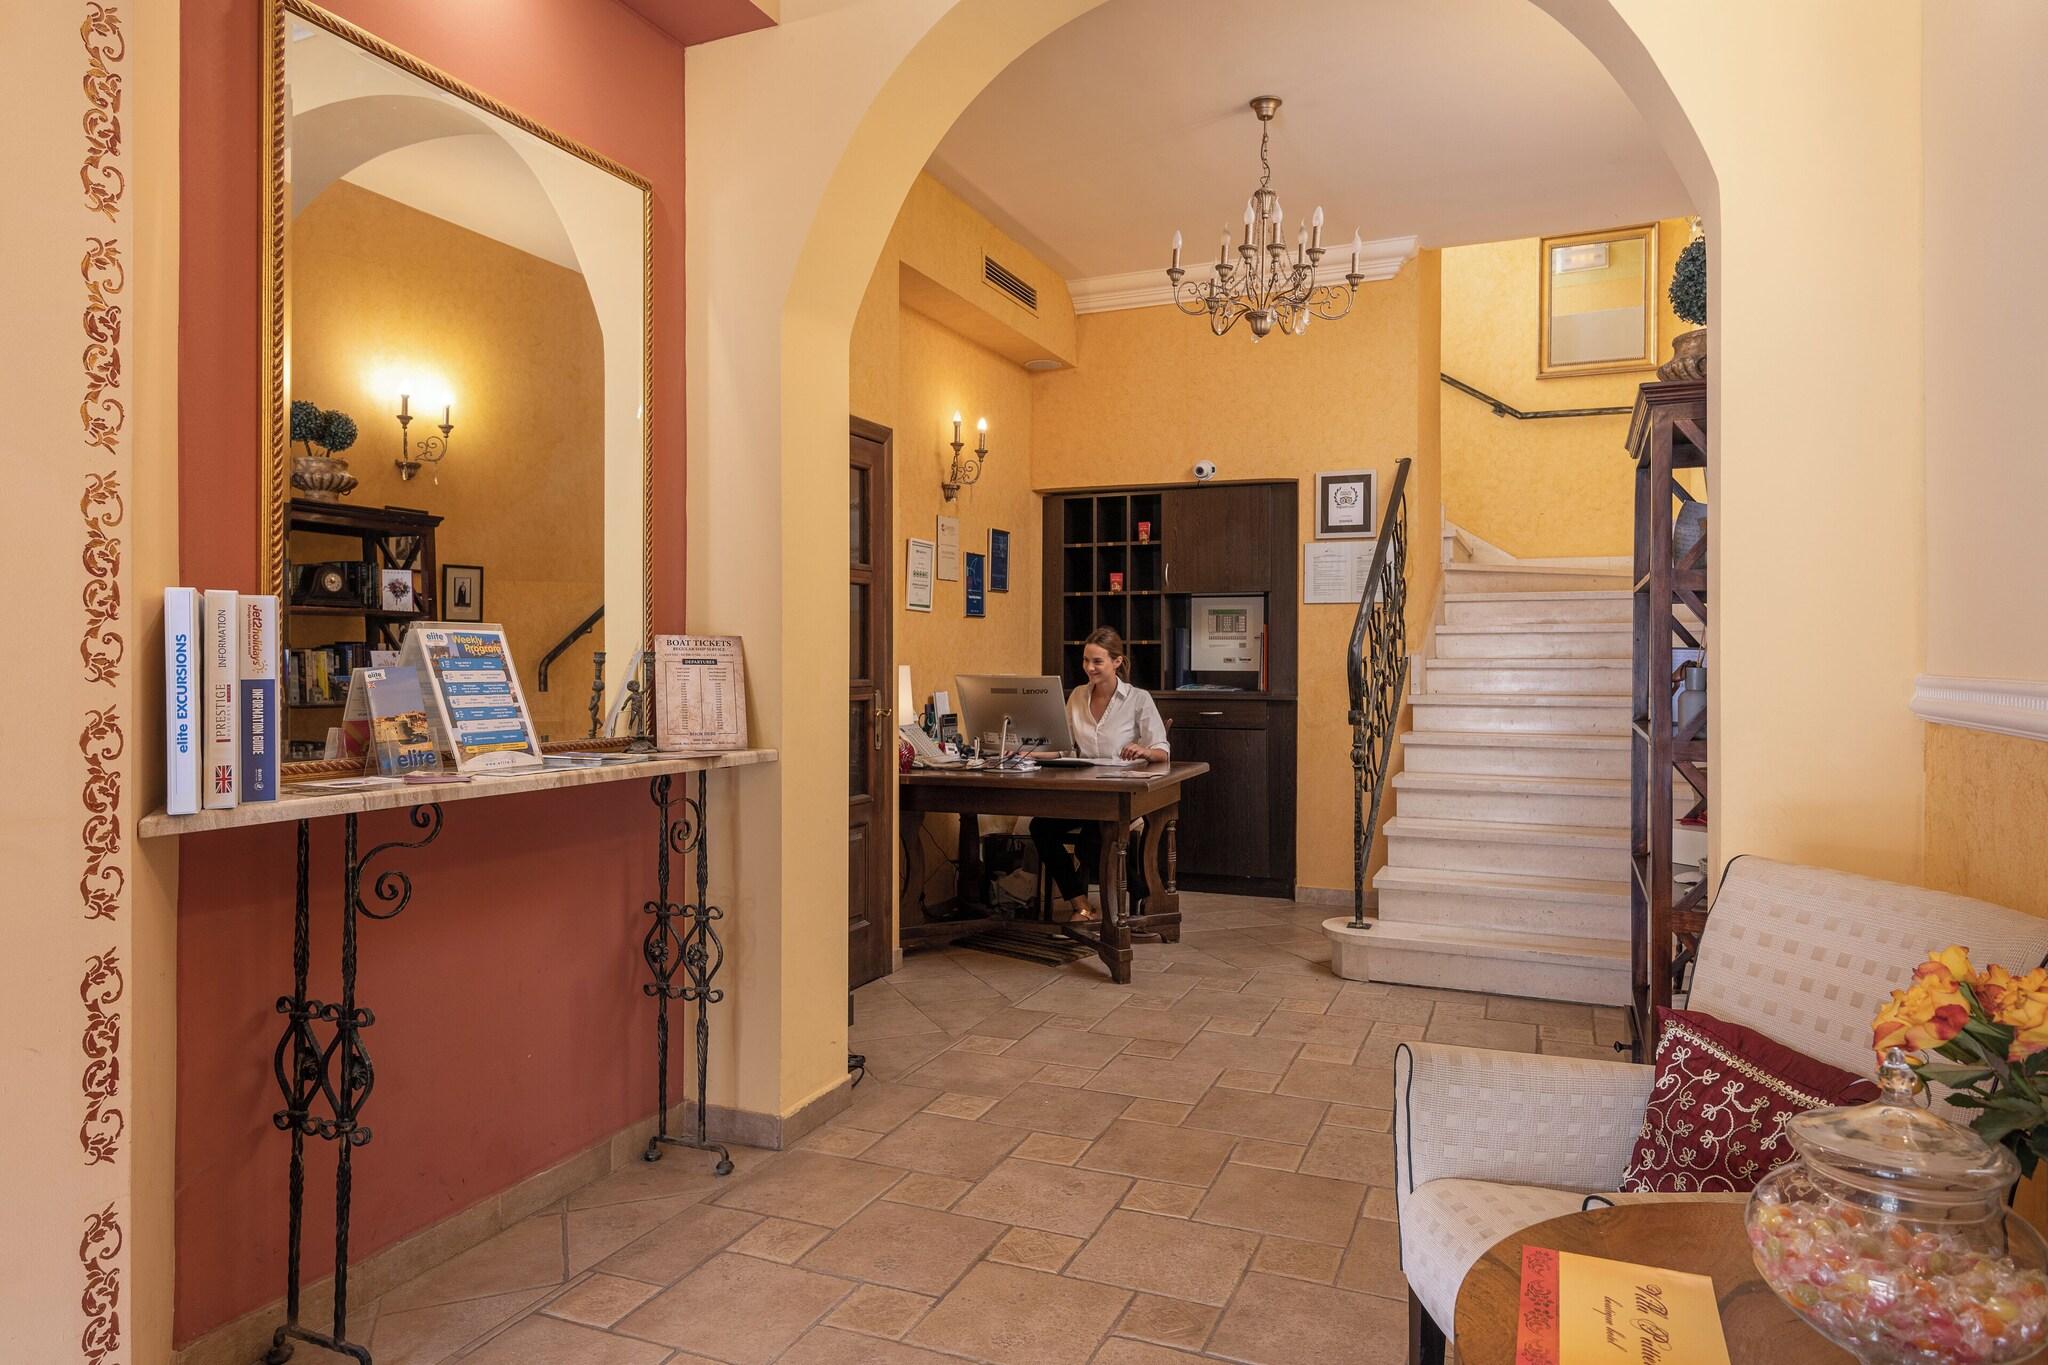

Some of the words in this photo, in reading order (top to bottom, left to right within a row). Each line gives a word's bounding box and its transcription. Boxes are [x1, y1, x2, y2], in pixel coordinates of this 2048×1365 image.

[217, 609, 227, 668] INFORMATION
[250, 604, 262, 666] Jet2holidays
[426, 631, 444, 640] elite
[452, 634, 483, 646] Weekly
[666, 639, 691, 647] BOAT
[693, 639, 732, 647] TICKETS
[463, 643, 501, 656] Program
[175, 633, 188, 720] EXCURSIONS
[1022, 687, 1049, 695] Lenovo
[215, 684, 226, 738] PRESTIGE
[252, 688, 264, 734] INFORMATION
[176, 723, 188, 754] elite
[252, 735, 264, 755] GUIDE
[397, 749, 437, 768] elite
[1634, 1284, 1669, 1320] Villa
[1605, 1326, 1629, 1353] hotel
